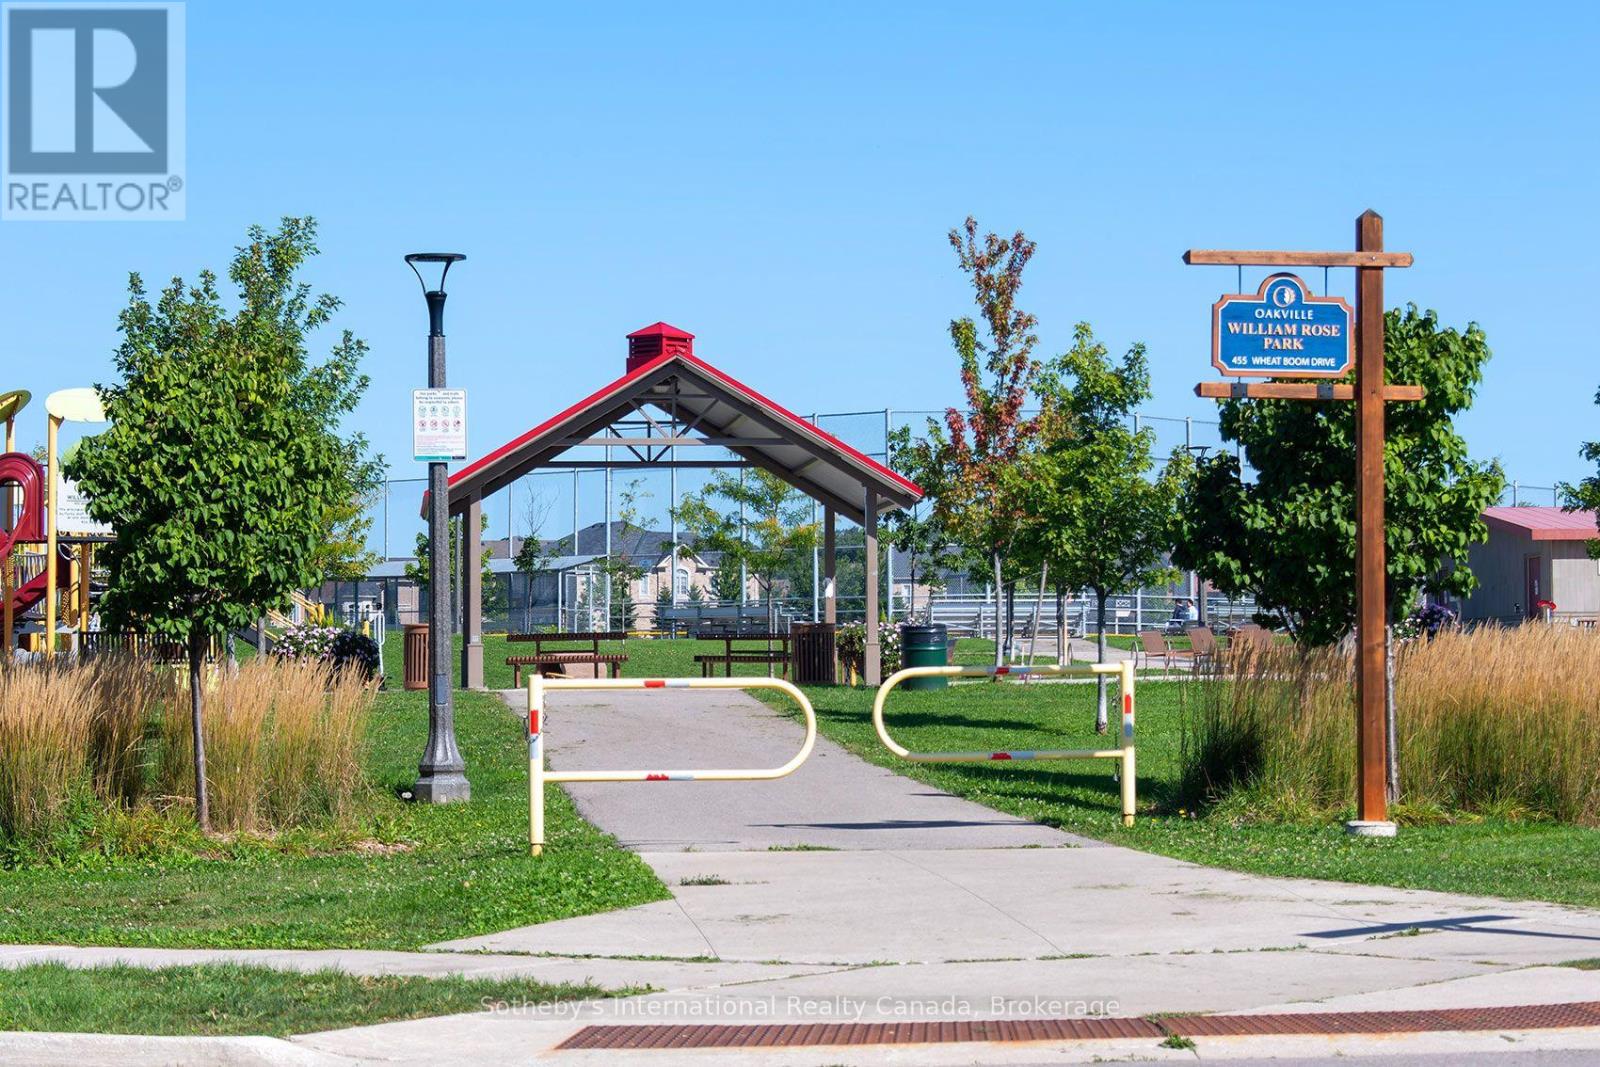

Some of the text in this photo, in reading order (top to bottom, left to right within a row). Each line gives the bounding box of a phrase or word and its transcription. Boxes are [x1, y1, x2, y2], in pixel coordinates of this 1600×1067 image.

[1254, 308, 1313, 320] OAKVILLE
[1227, 322, 1341, 336] WILLIAM ROSE
[1263, 338, 1304, 350] PARK
[1231, 356, 1336, 367] 455 WHEAT BOOM DRIVE
